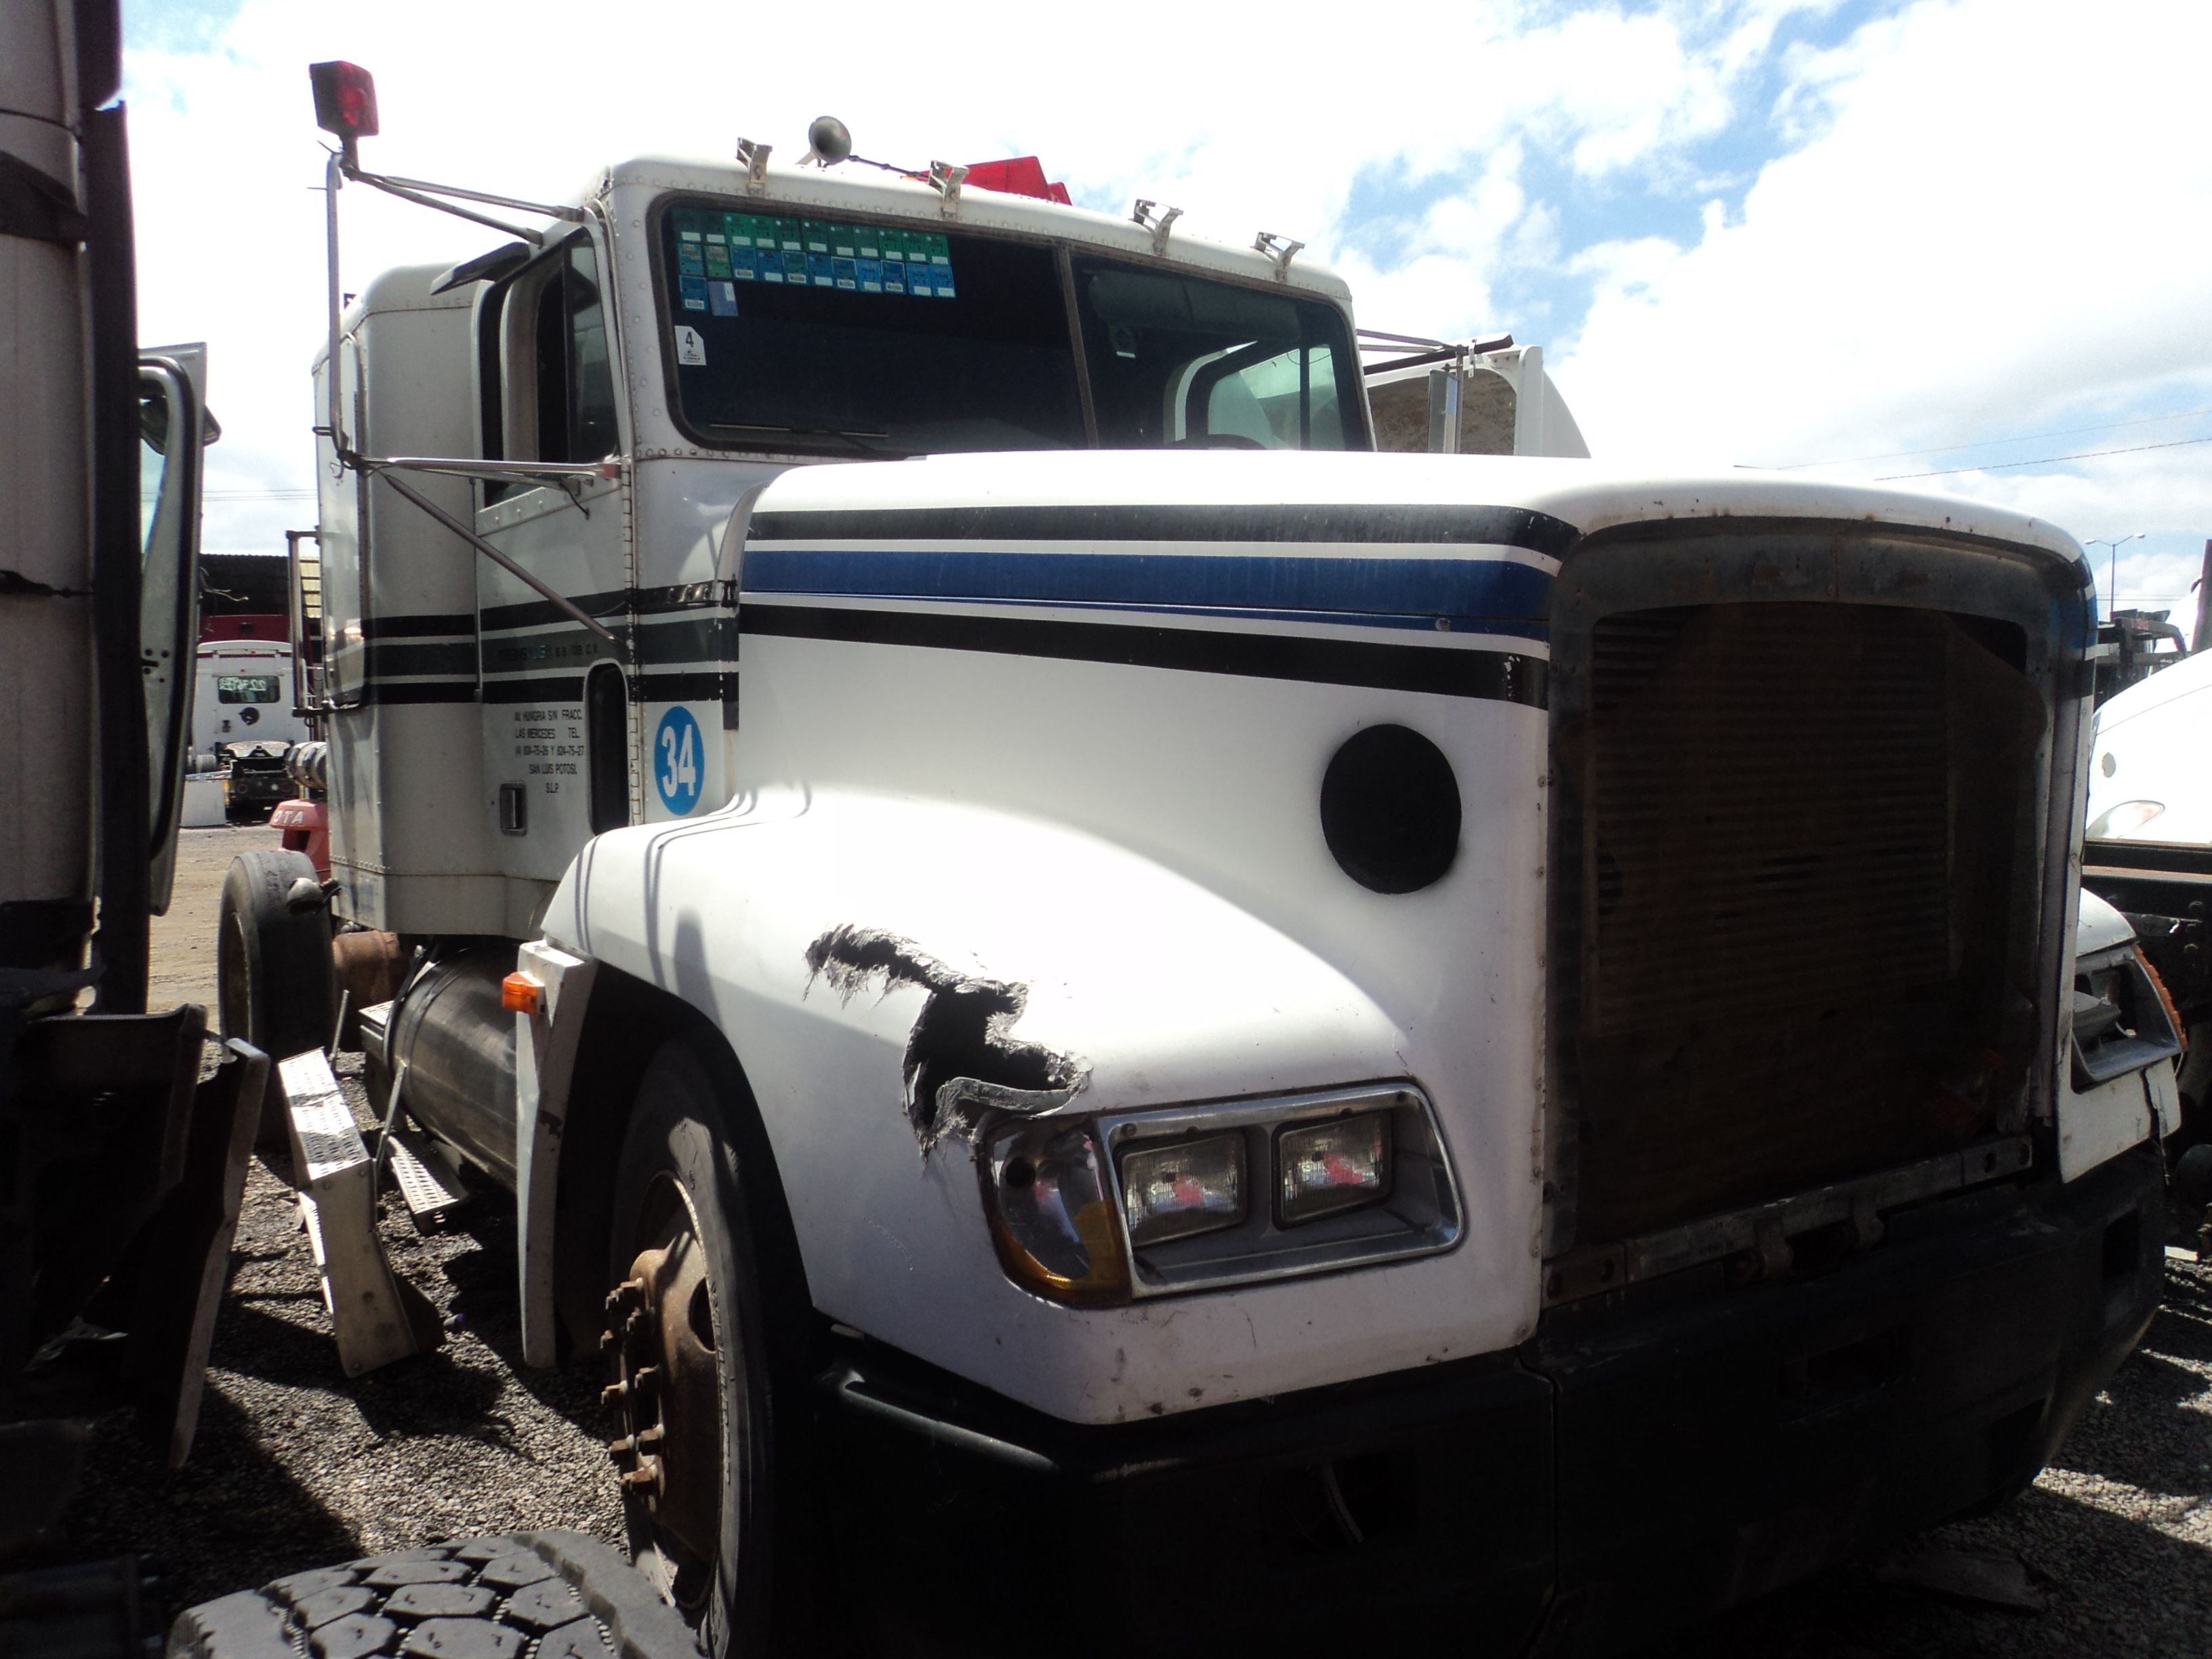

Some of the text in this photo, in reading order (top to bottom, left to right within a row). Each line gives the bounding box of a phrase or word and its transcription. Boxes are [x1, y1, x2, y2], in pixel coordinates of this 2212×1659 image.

[685, 331, 694, 348] 4
[515, 728, 525, 739] LAS
[527, 728, 556, 739] MERCEDES
[661, 724, 697, 798] 34
[529, 764, 540, 775] SAN
[541, 764, 554, 775] LUIS
